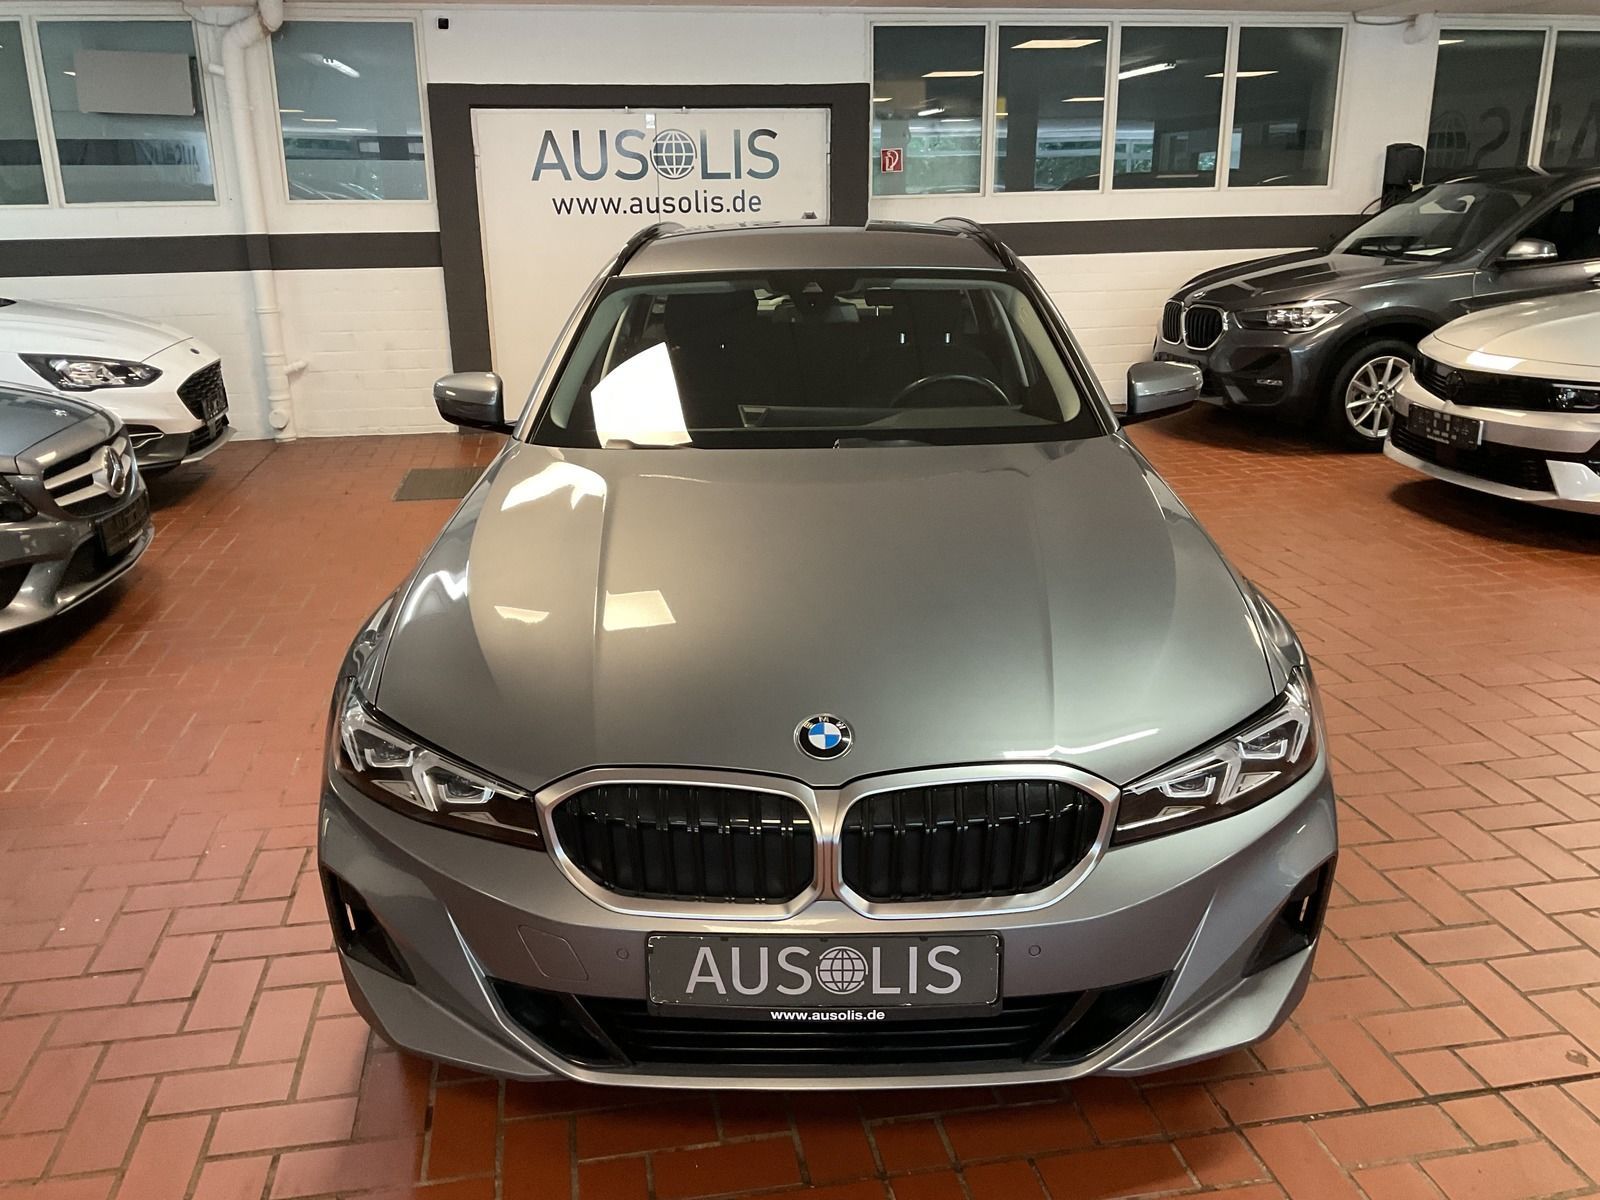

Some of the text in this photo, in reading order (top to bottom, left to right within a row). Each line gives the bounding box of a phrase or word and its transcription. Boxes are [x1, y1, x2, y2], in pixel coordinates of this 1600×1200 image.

[531, 128, 780, 182] AUSOLIS
[552, 190, 762, 215] www.ausolis.de
[685, 945, 962, 995] AUSOLIS
[770, 1009, 886, 1021] www.ausolis.de
